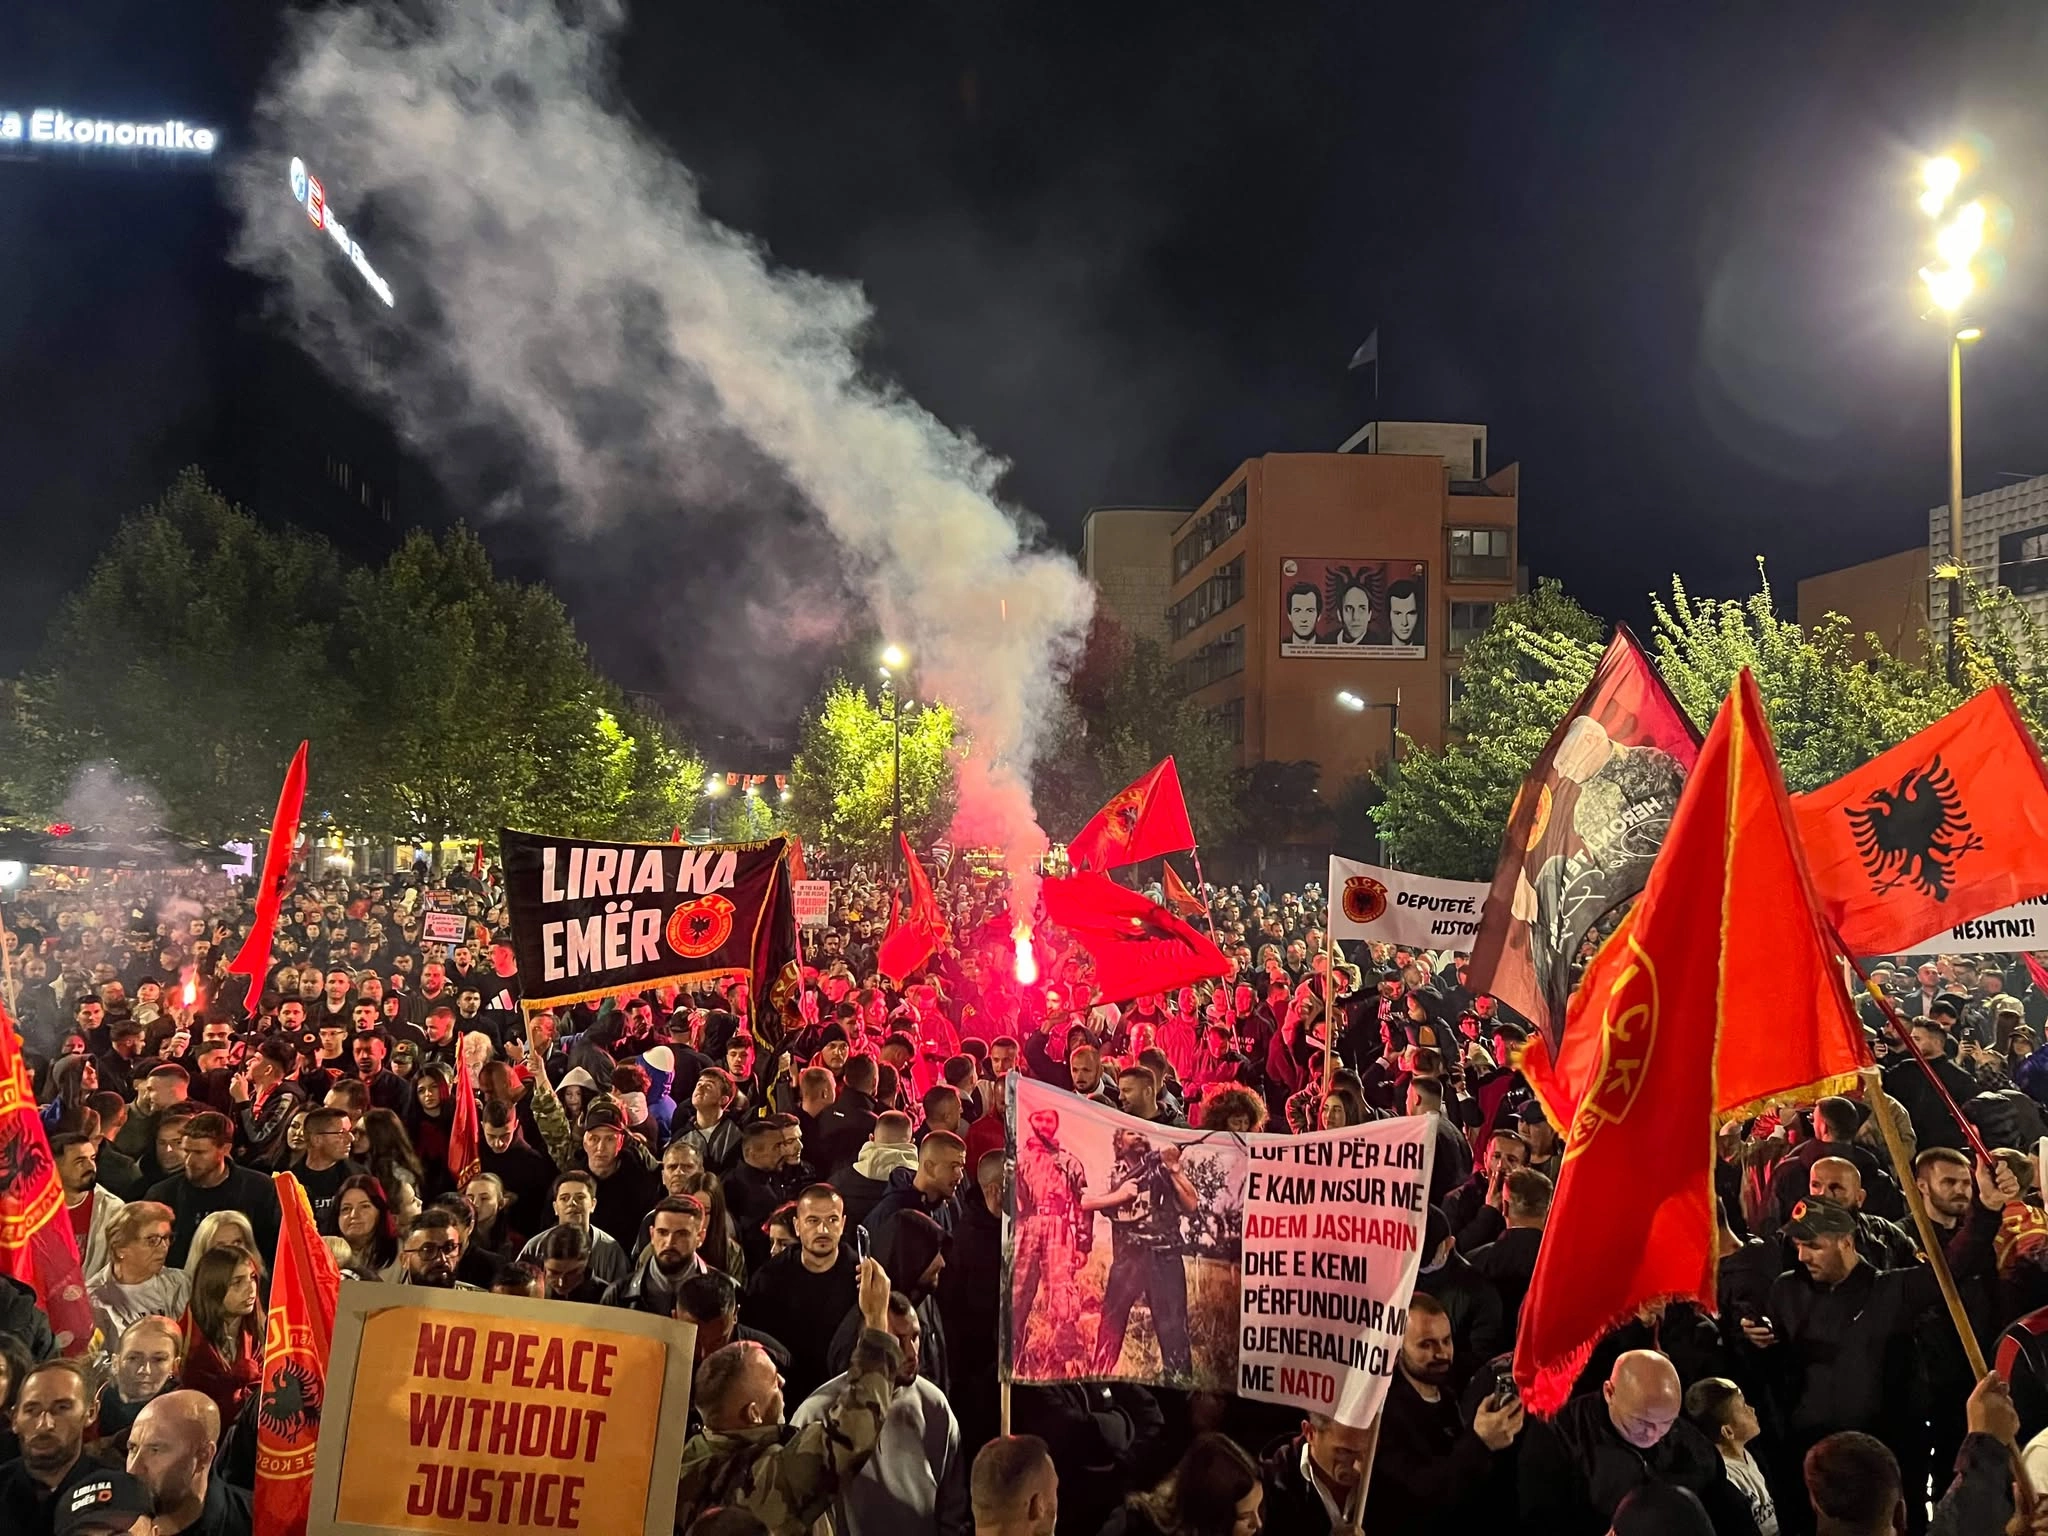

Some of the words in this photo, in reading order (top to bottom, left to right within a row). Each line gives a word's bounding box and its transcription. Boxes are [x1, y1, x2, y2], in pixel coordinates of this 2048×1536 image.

[0, 110, 20, 138] a
[542, 847, 664, 904] LIRIA
[676, 849, 737, 894] KA
[542, 900, 662, 982] EMËR
[1953, 917, 2035, 940] HESHTNI!
[1338, 1138, 1379, 1169] PËR
[1384, 1142, 1424, 1170] LIRI
[1248, 1172, 1262, 1200] E
[1265, 1174, 1315, 1205] KAM
[1320, 1179, 1385, 1206] NISUR
[1391, 1181, 1424, 1212] ME
[1245, 1214, 1307, 1239] ADEM
[1312, 1213, 1417, 1252] JASHARIN
[1245, 1251, 1287, 1277] DHE
[1293, 1251, 1306, 1276] E
[1312, 1253, 1367, 1284] KEMI
[1244, 1285, 1384, 1331] PËRFUNDUAR
[1386, 1305, 1408, 1336] M
[413, 1322, 477, 1382] NO
[481, 1330, 618, 1397] PEACE
[1243, 1326, 1369, 1372] GJENERALIN
[1241, 1364, 1275, 1392] ME
[1280, 1367, 1335, 1404] NATO
[409, 1392, 607, 1463] WITHOUT
[406, 1463, 585, 1529] JUSTICE
